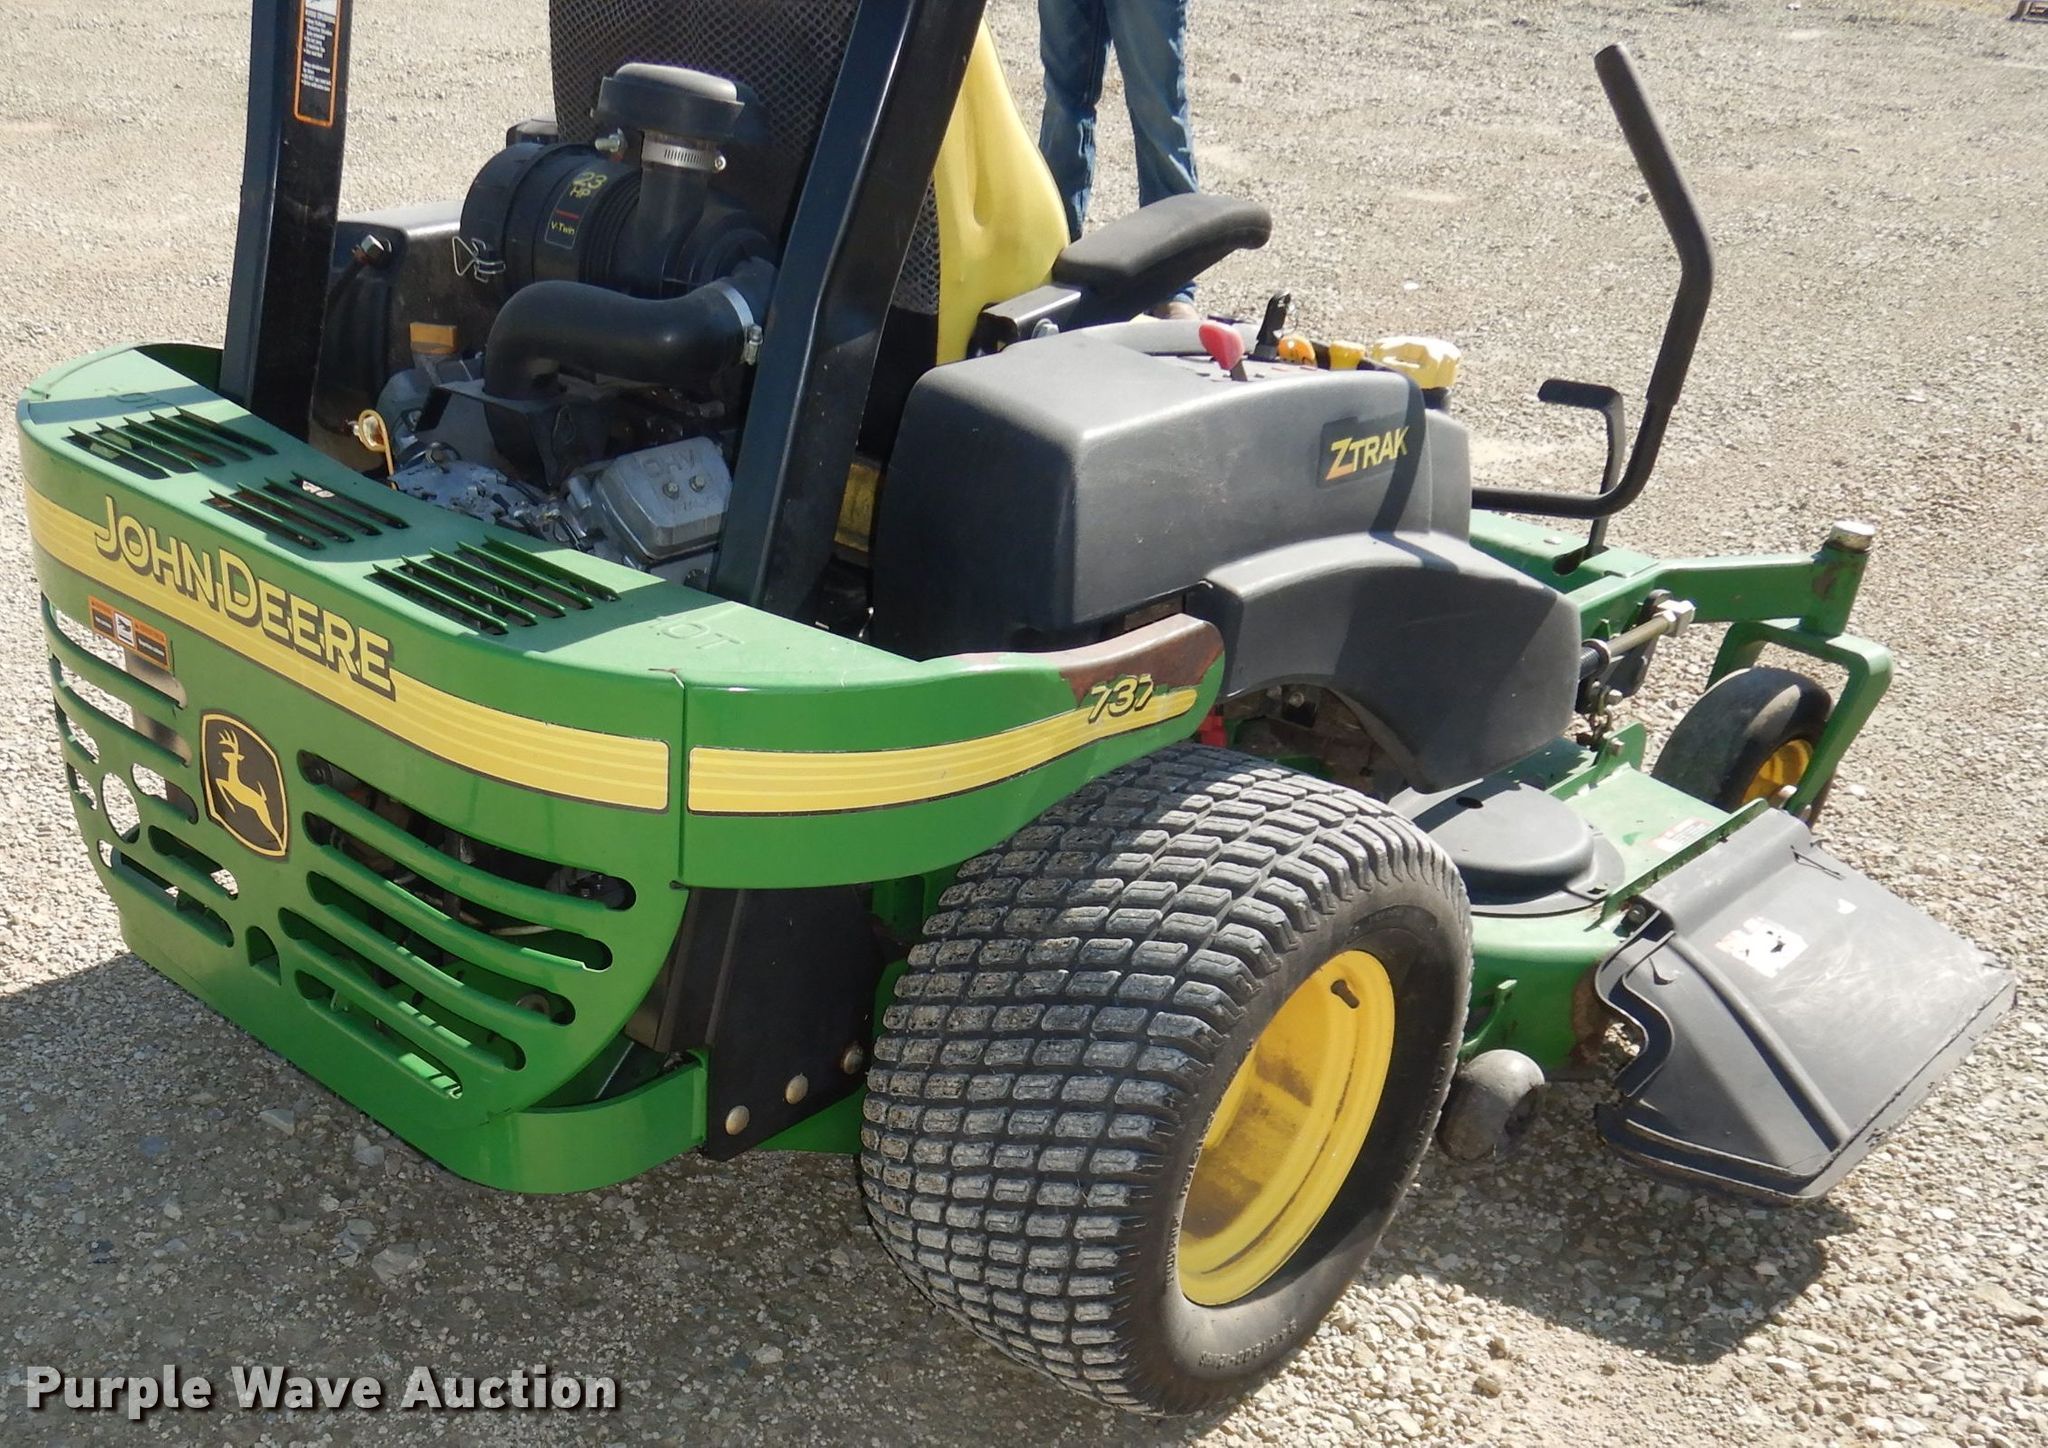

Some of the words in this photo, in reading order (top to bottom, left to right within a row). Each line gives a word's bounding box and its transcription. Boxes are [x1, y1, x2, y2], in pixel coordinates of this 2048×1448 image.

[569, 186, 592, 199] HP
[572, 171, 608, 190] 23
[551, 220, 575, 236] V-Twin
[1325, 426, 1410, 480] ZTRAK
[94, 494, 220, 612] JOHN
[218, 547, 396, 701] DEERE
[1087, 673, 1154, 724] 737
